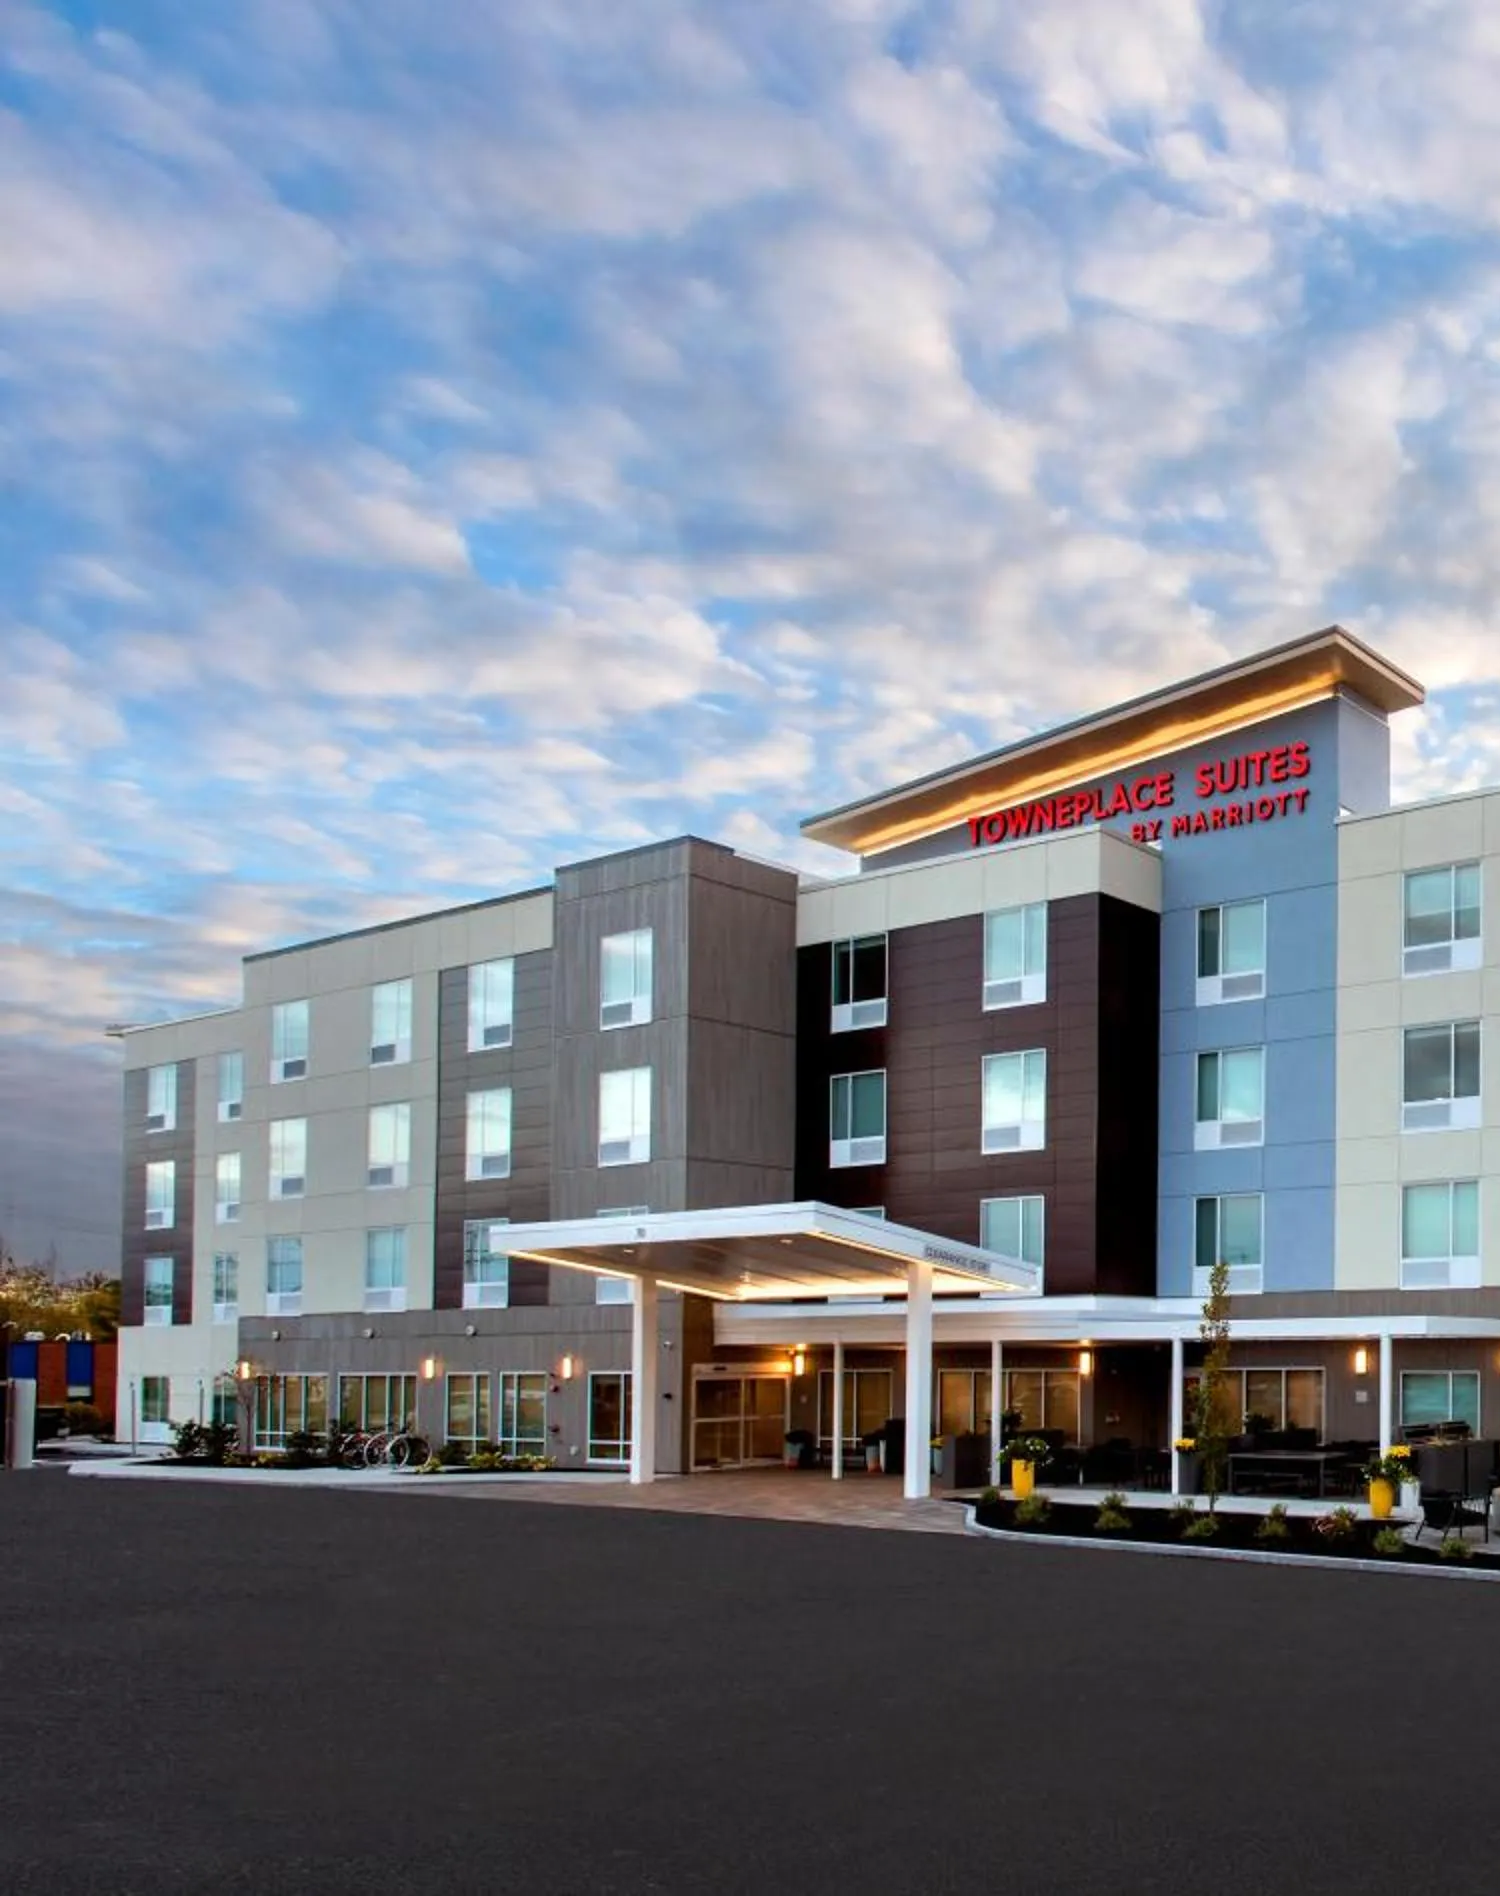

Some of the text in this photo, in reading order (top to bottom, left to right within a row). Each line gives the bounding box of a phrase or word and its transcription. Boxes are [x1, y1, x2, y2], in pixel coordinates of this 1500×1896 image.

[967, 741, 1310, 846] TOWNEPLACE SUITES
[1131, 788, 1310, 843] BY MARRIOTT
